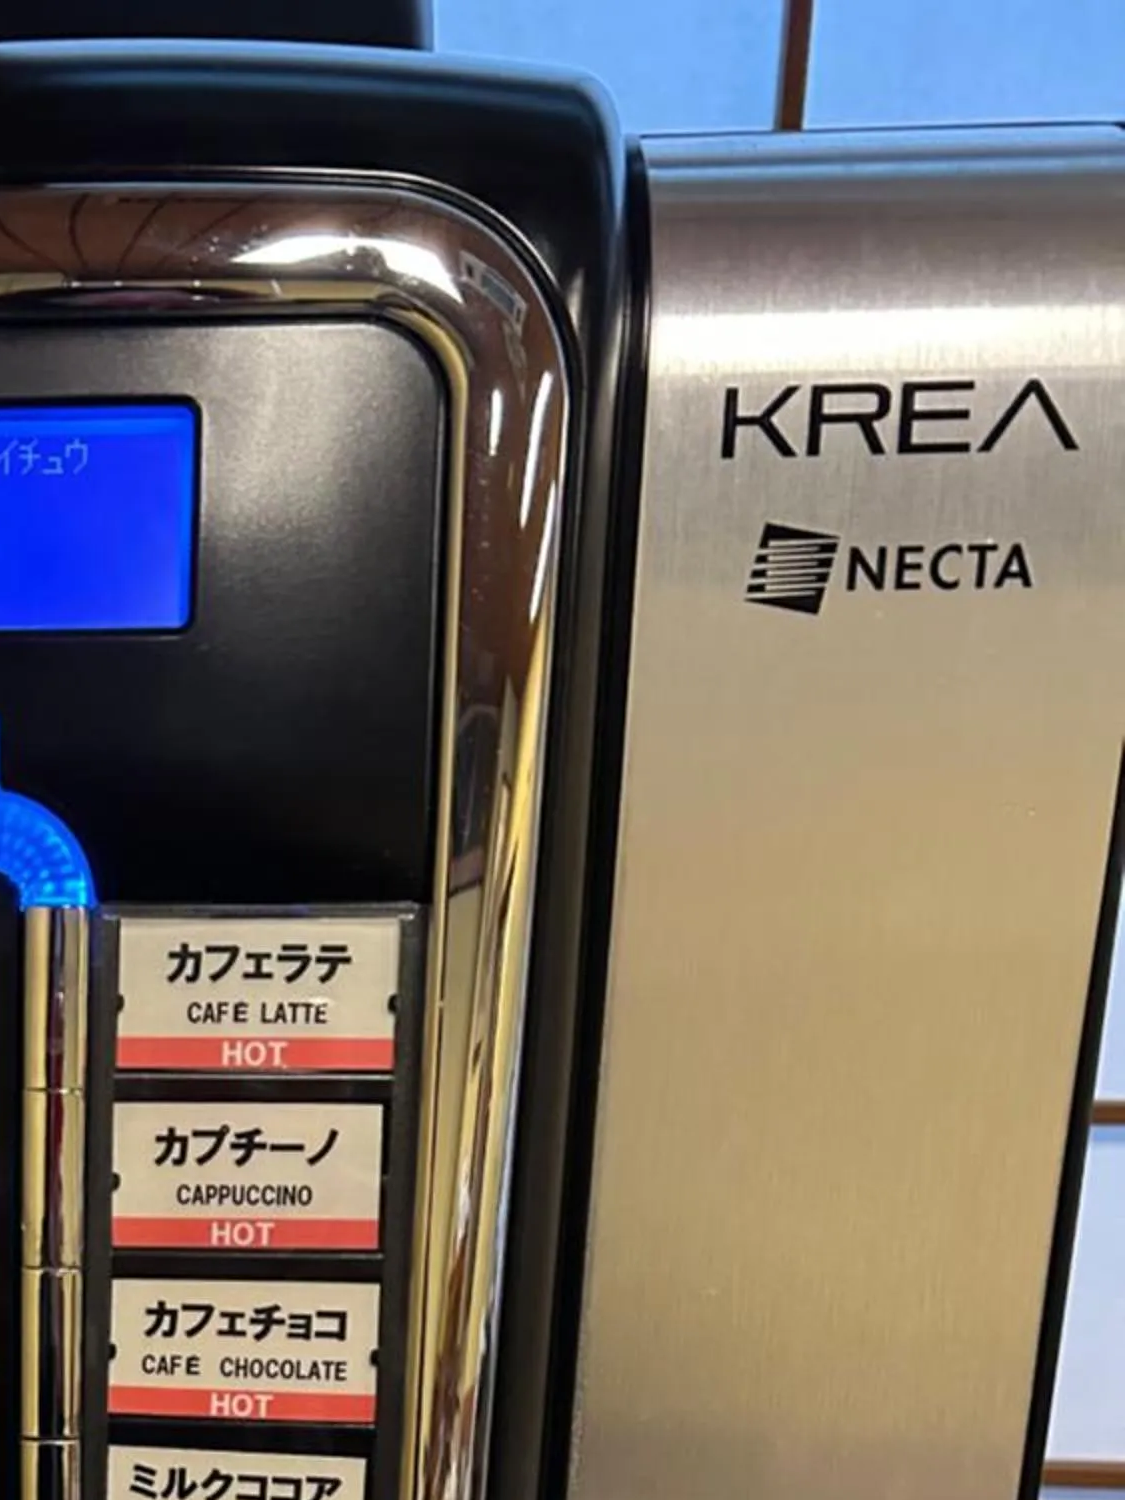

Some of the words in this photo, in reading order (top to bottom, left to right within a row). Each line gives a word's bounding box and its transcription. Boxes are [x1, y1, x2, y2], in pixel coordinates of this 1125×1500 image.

[720, 377, 1081, 459] KREA
[846, 542, 1033, 592] NECTA
[166, 942, 352, 984] カフェラテ
[261, 1002, 328, 1024] LATTE
[221, 1041, 288, 1066] HOT
[154, 1124, 339, 1167] カプチーノ
[177, 1184, 313, 1206] CAPPUCCINO
[210, 1221, 275, 1246] HOT
[144, 1301, 348, 1341] カフェチョコ
[219, 1356, 347, 1382] CHOCOLATE
[210, 1393, 274, 1418] HOT
